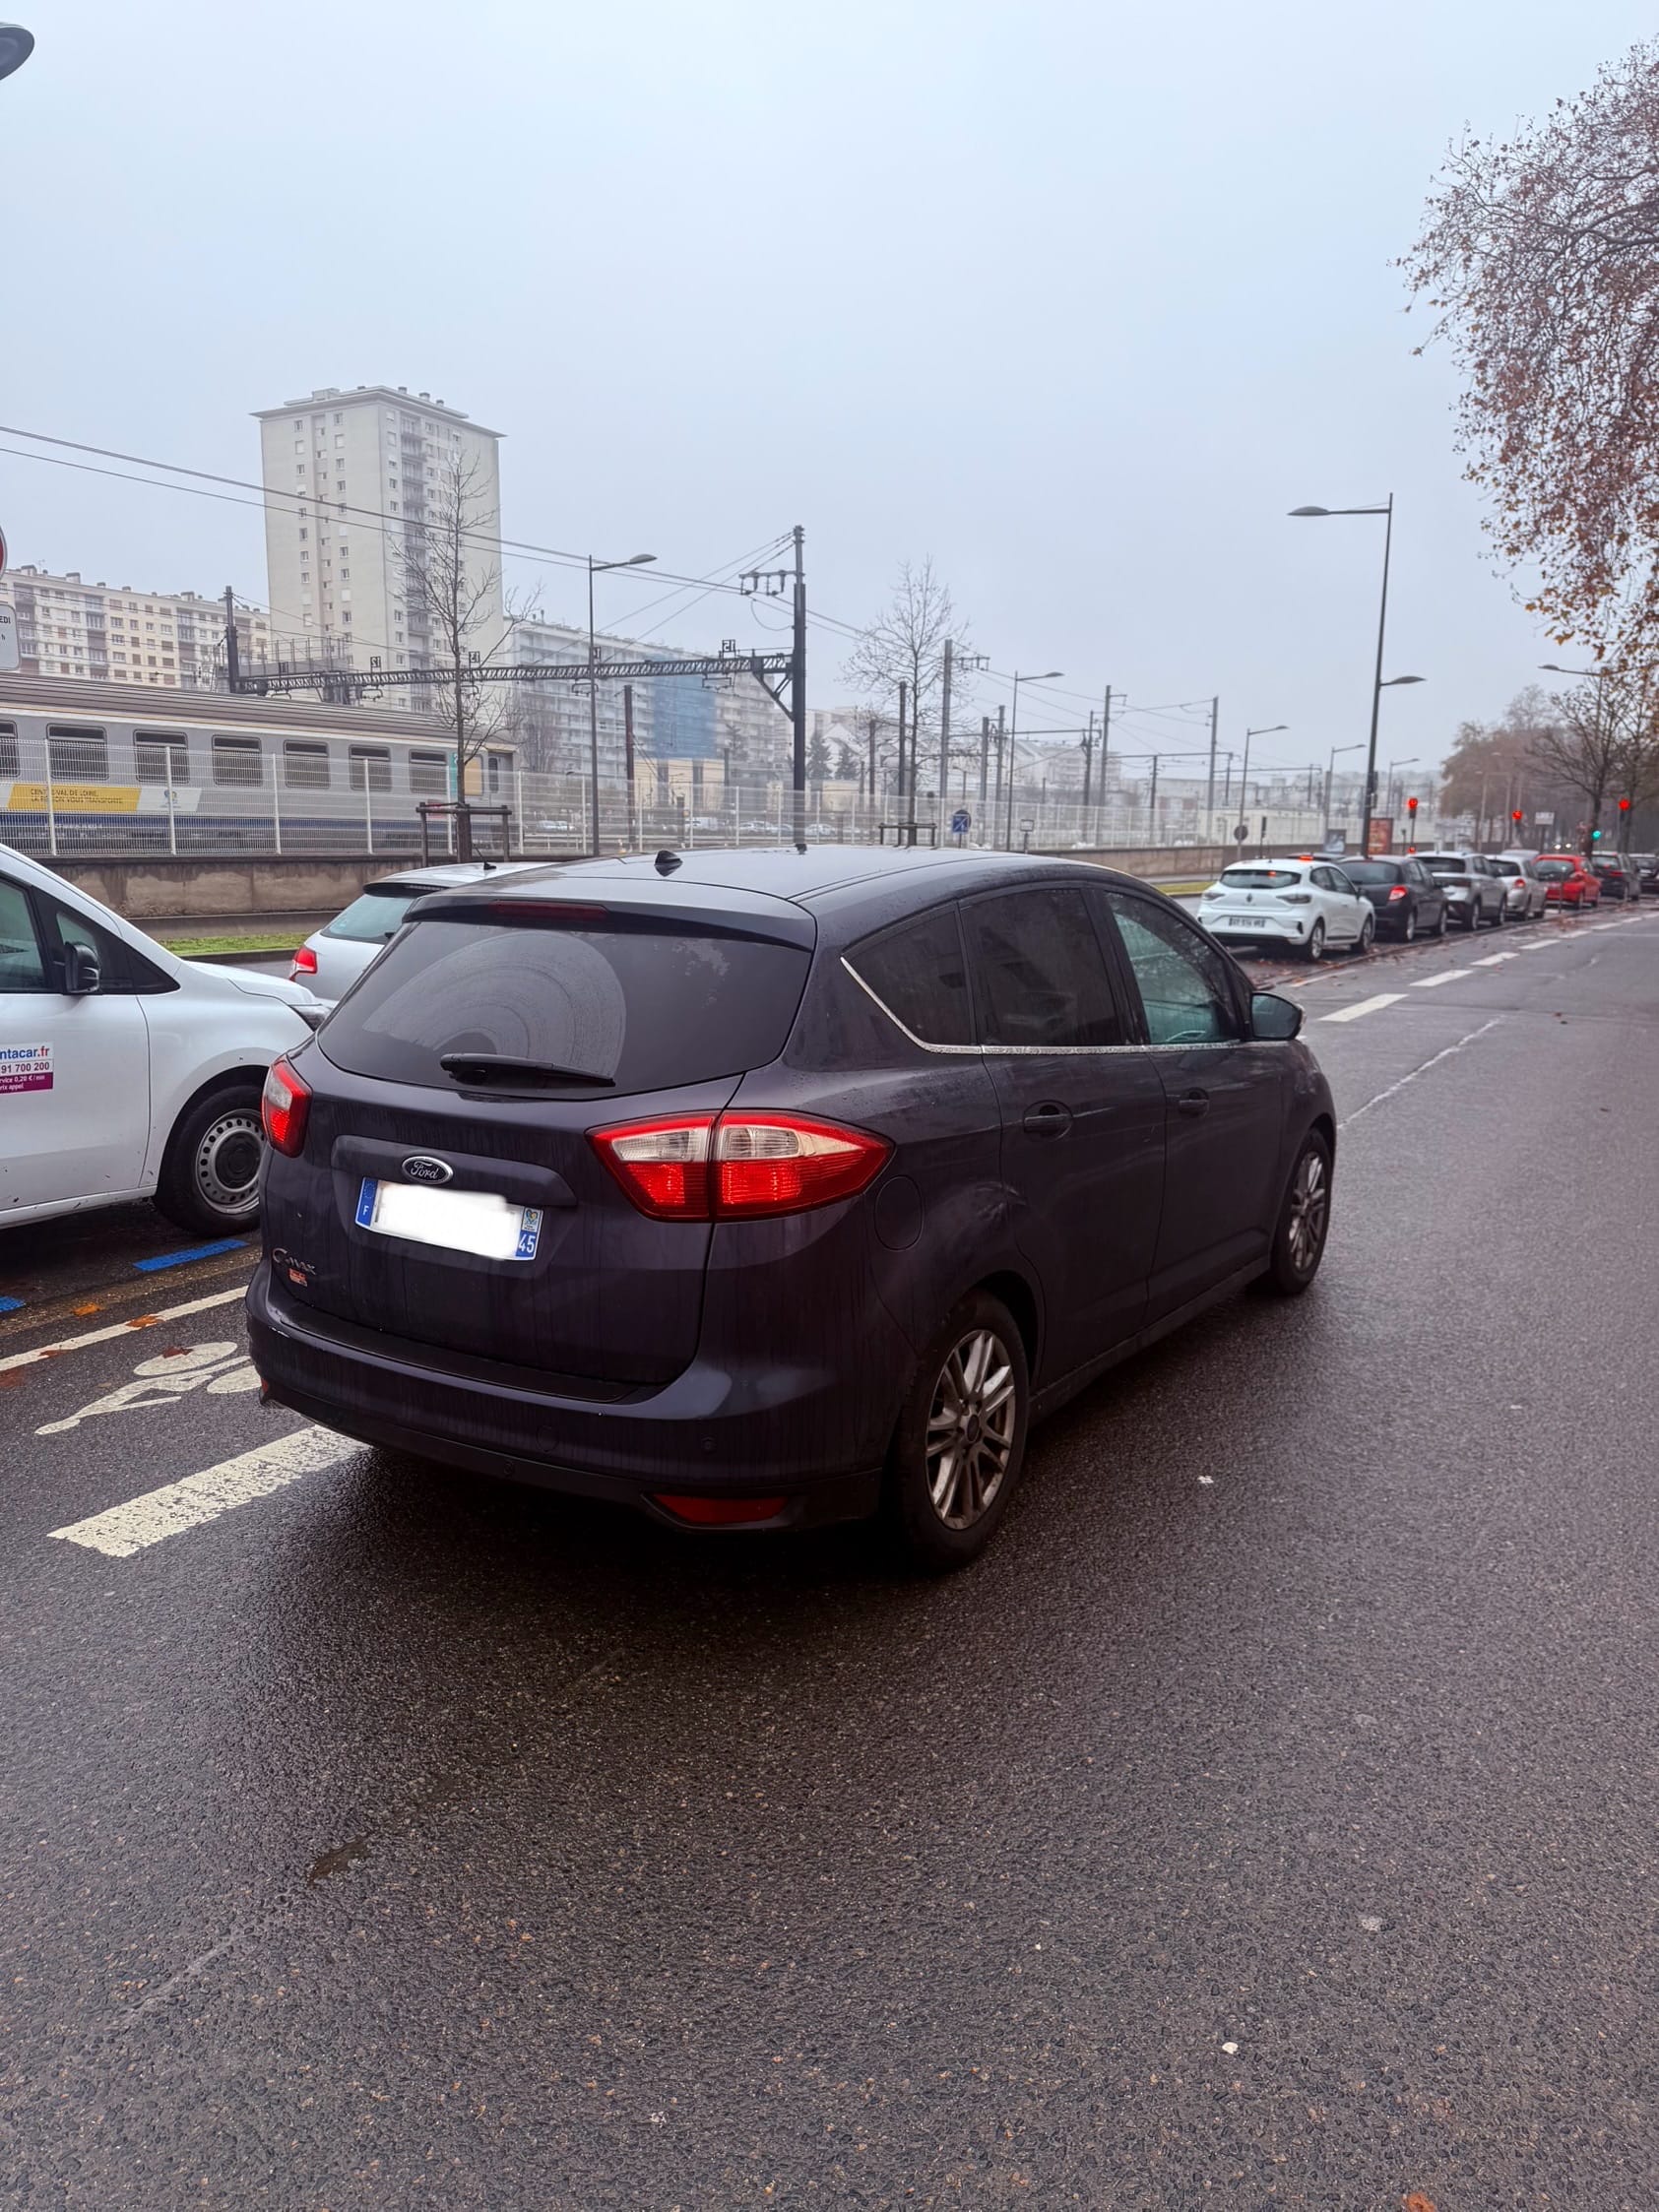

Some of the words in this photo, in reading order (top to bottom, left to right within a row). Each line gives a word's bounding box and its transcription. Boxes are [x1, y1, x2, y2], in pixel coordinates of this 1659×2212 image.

[1, 1064, 12, 1073] 91
[15, 1063, 31, 1072] 700
[34, 1062, 49, 1071] 200
[411, 1161, 439, 1179] Ford
[362, 1205, 369, 1216] F
[518, 1233, 536, 1253] 45
